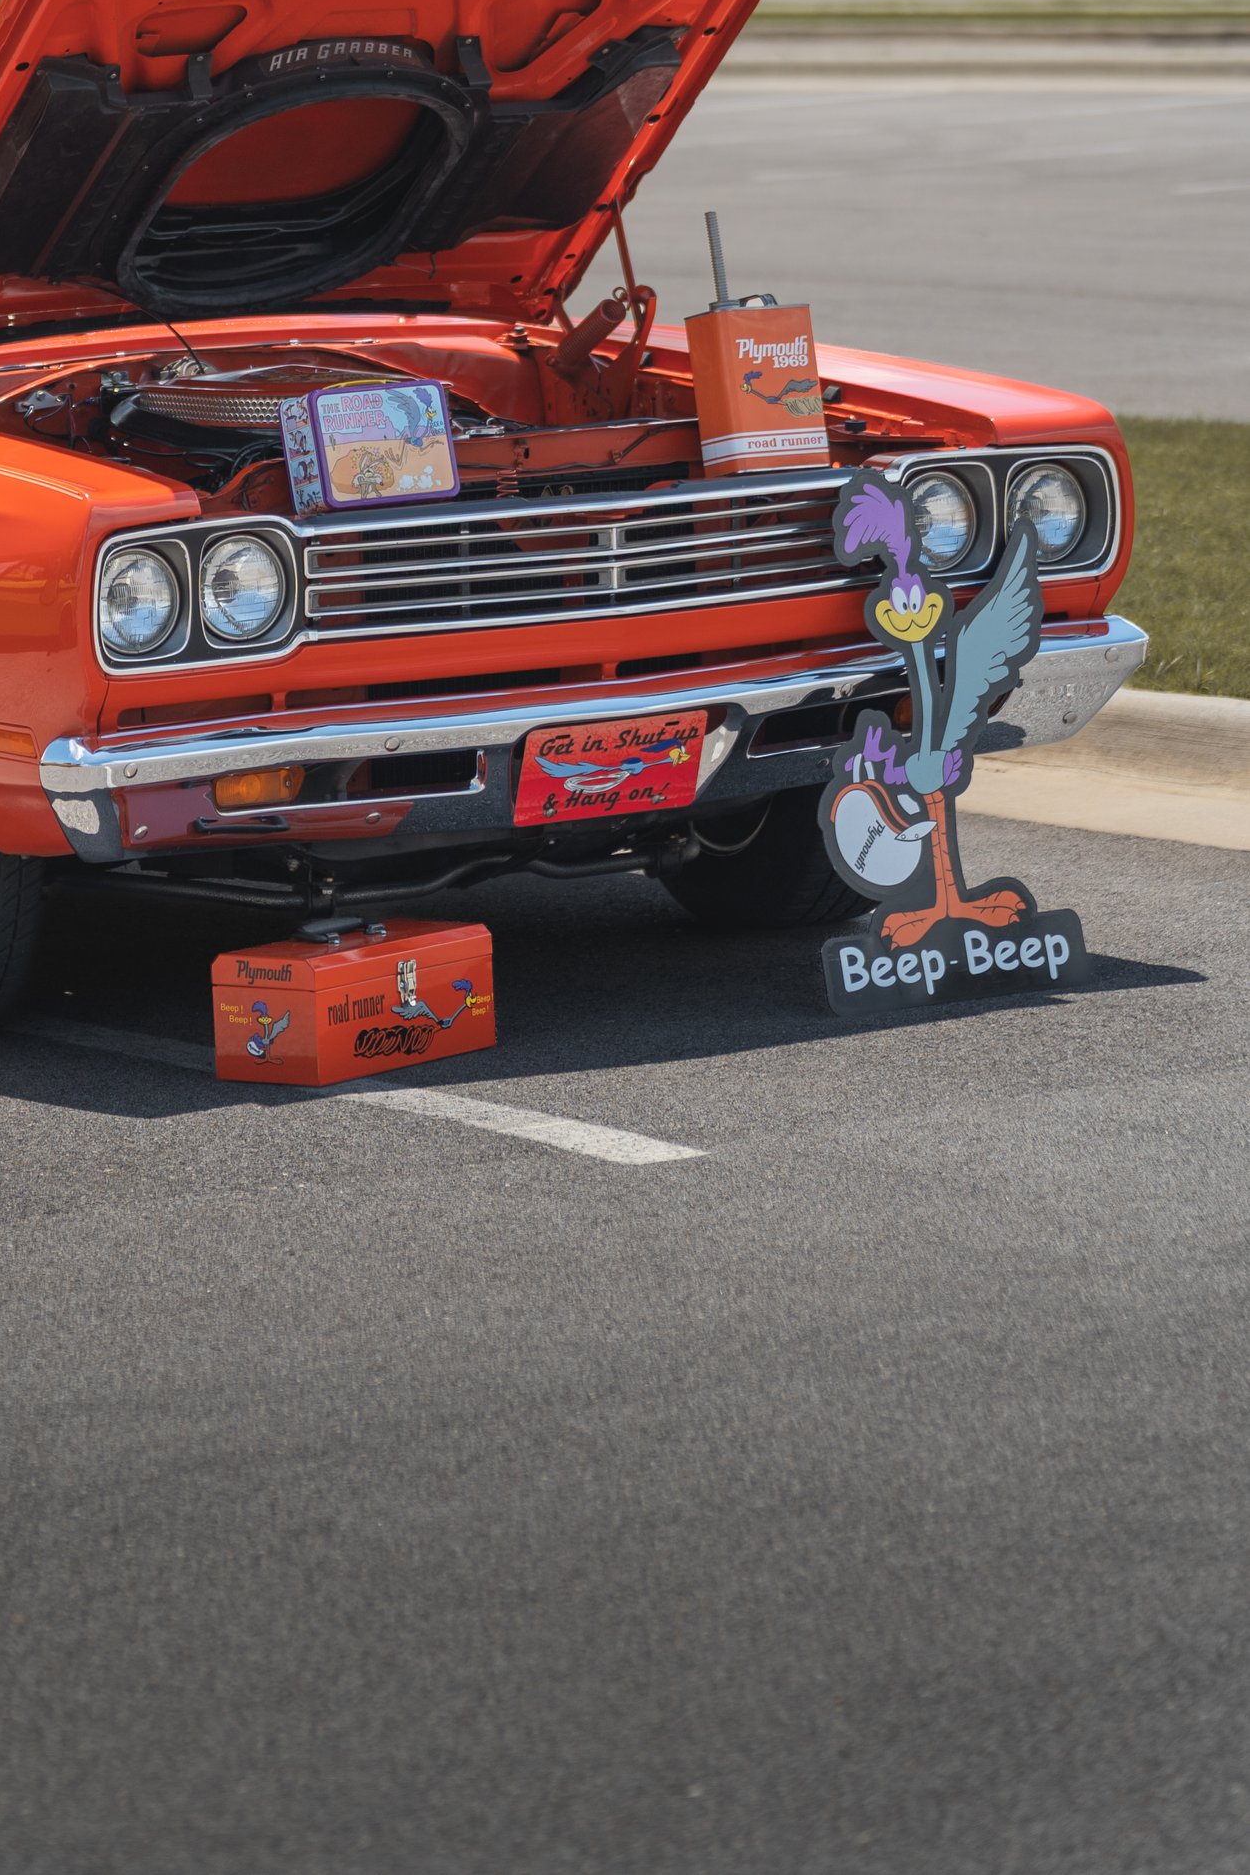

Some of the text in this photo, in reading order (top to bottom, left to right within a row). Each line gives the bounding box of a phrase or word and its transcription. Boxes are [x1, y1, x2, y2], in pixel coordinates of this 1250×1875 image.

[269, 41, 413, 72] AIR GRABBER
[735, 335, 808, 365] Plymouth
[772, 355, 809, 369] 1969
[320, 392, 384, 415] THE ROAD
[322, 409, 388, 432] RUNNER
[747, 435, 824, 450] road runner
[539, 726, 700, 757] Get in, Shut up
[542, 792, 560, 811] &
[565, 789, 621, 812] Hang
[854, 819, 886, 874] Plymouth
[236, 960, 292, 985] Plymouth
[327, 993, 386, 1026] road runner
